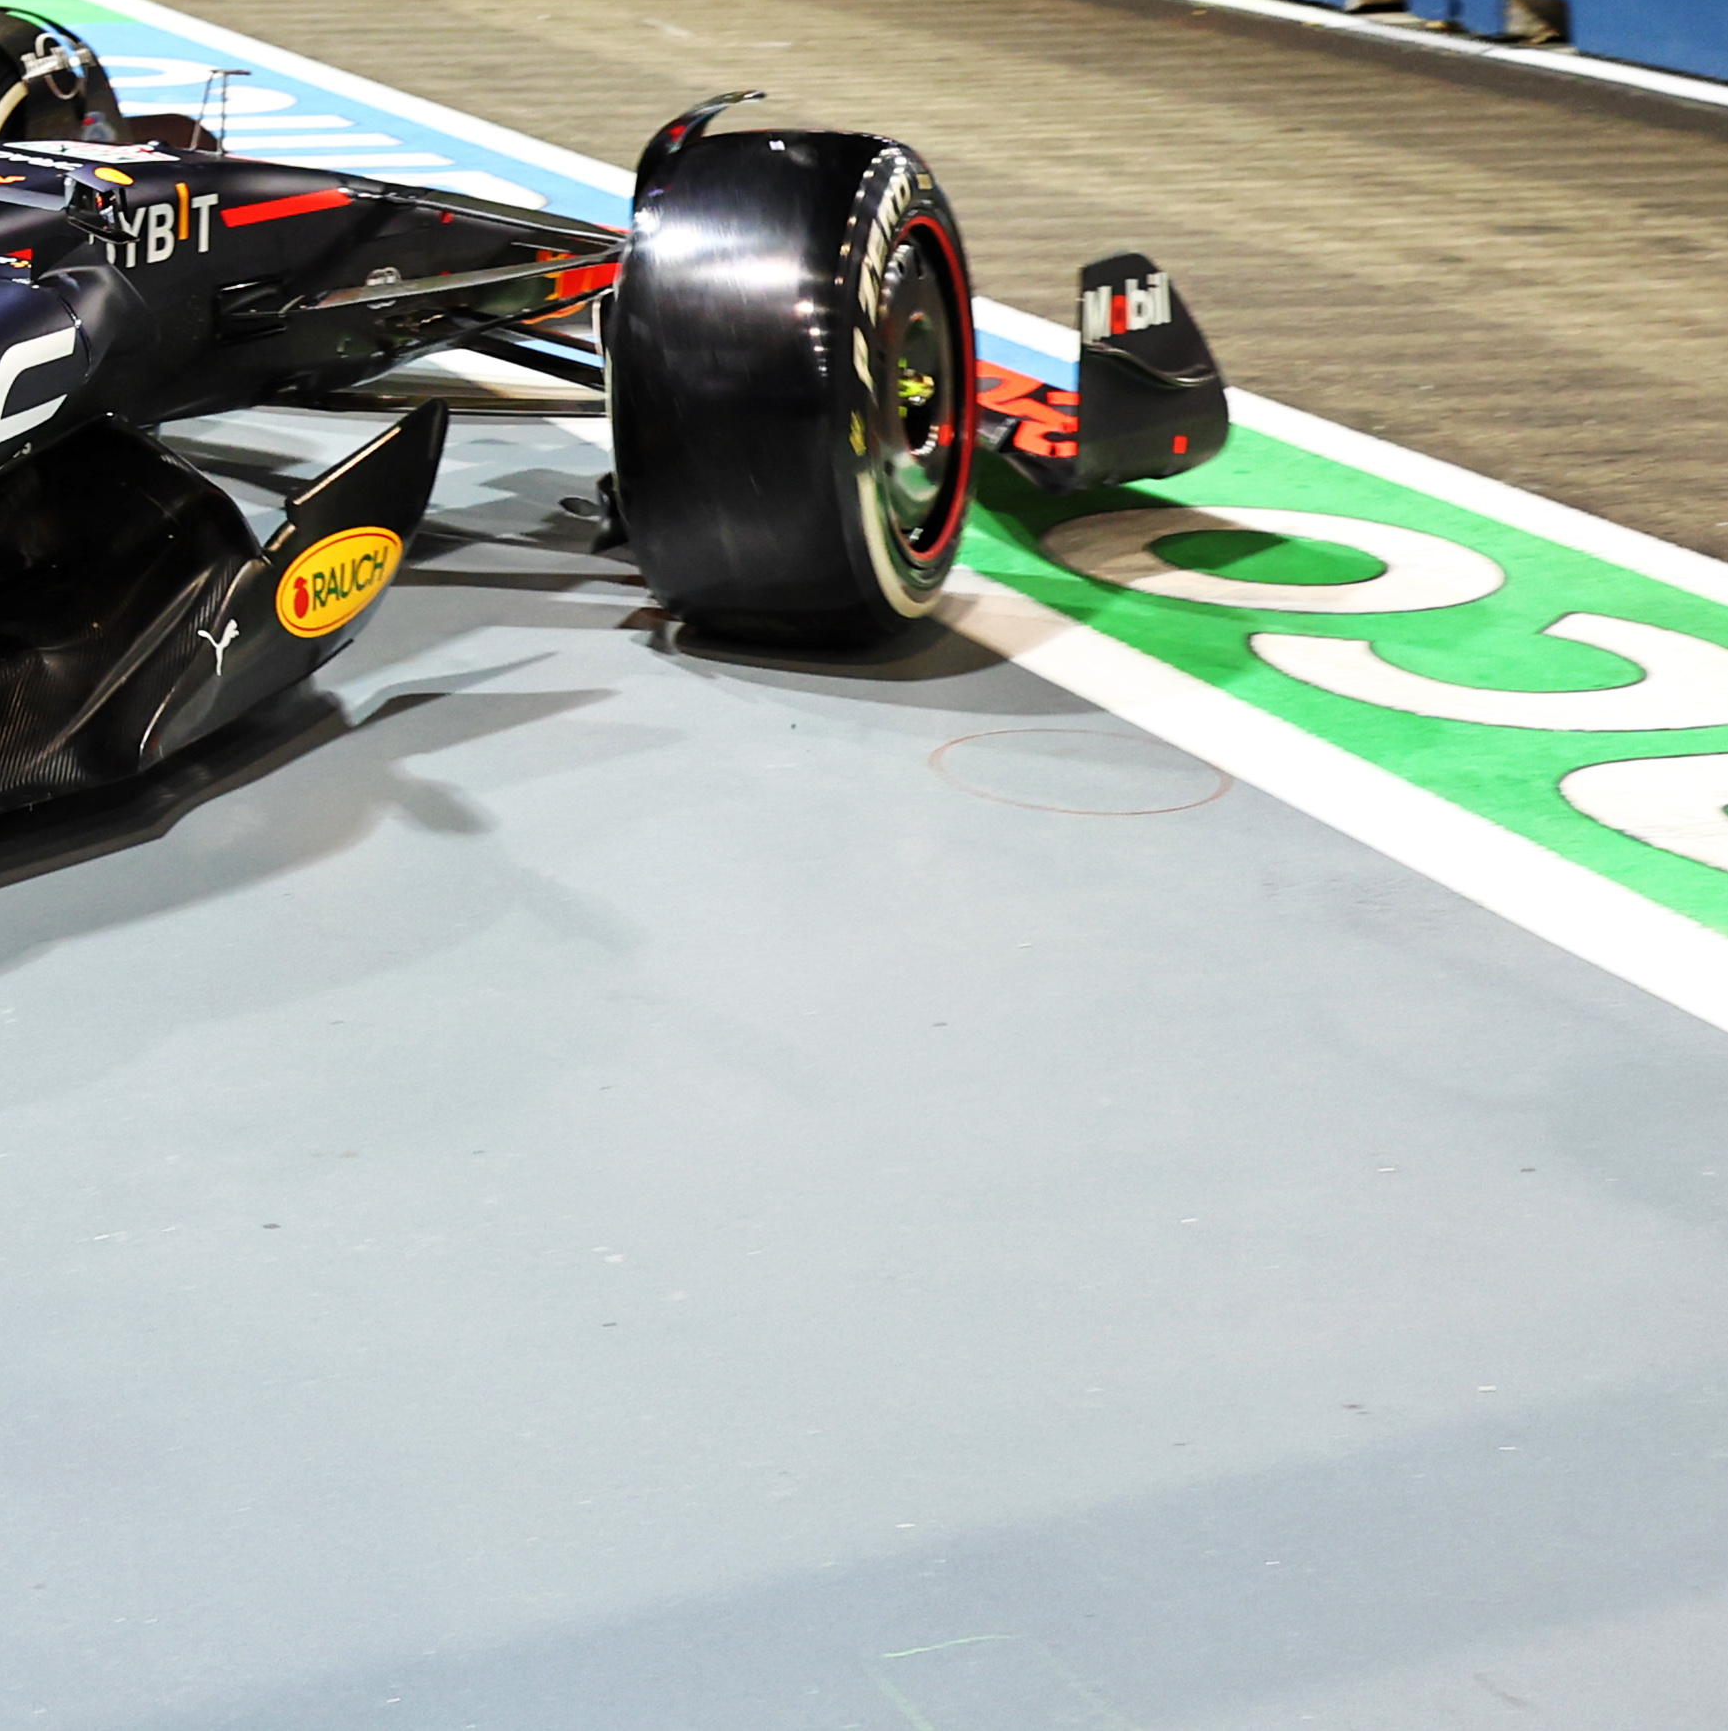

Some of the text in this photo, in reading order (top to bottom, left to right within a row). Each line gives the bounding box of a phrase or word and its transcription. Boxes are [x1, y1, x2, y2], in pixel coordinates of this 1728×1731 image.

[88, 181, 220, 268] YBIT
[1082, 271, 1171, 347] Mobil
[311, 552, 389, 611] RAUCH
